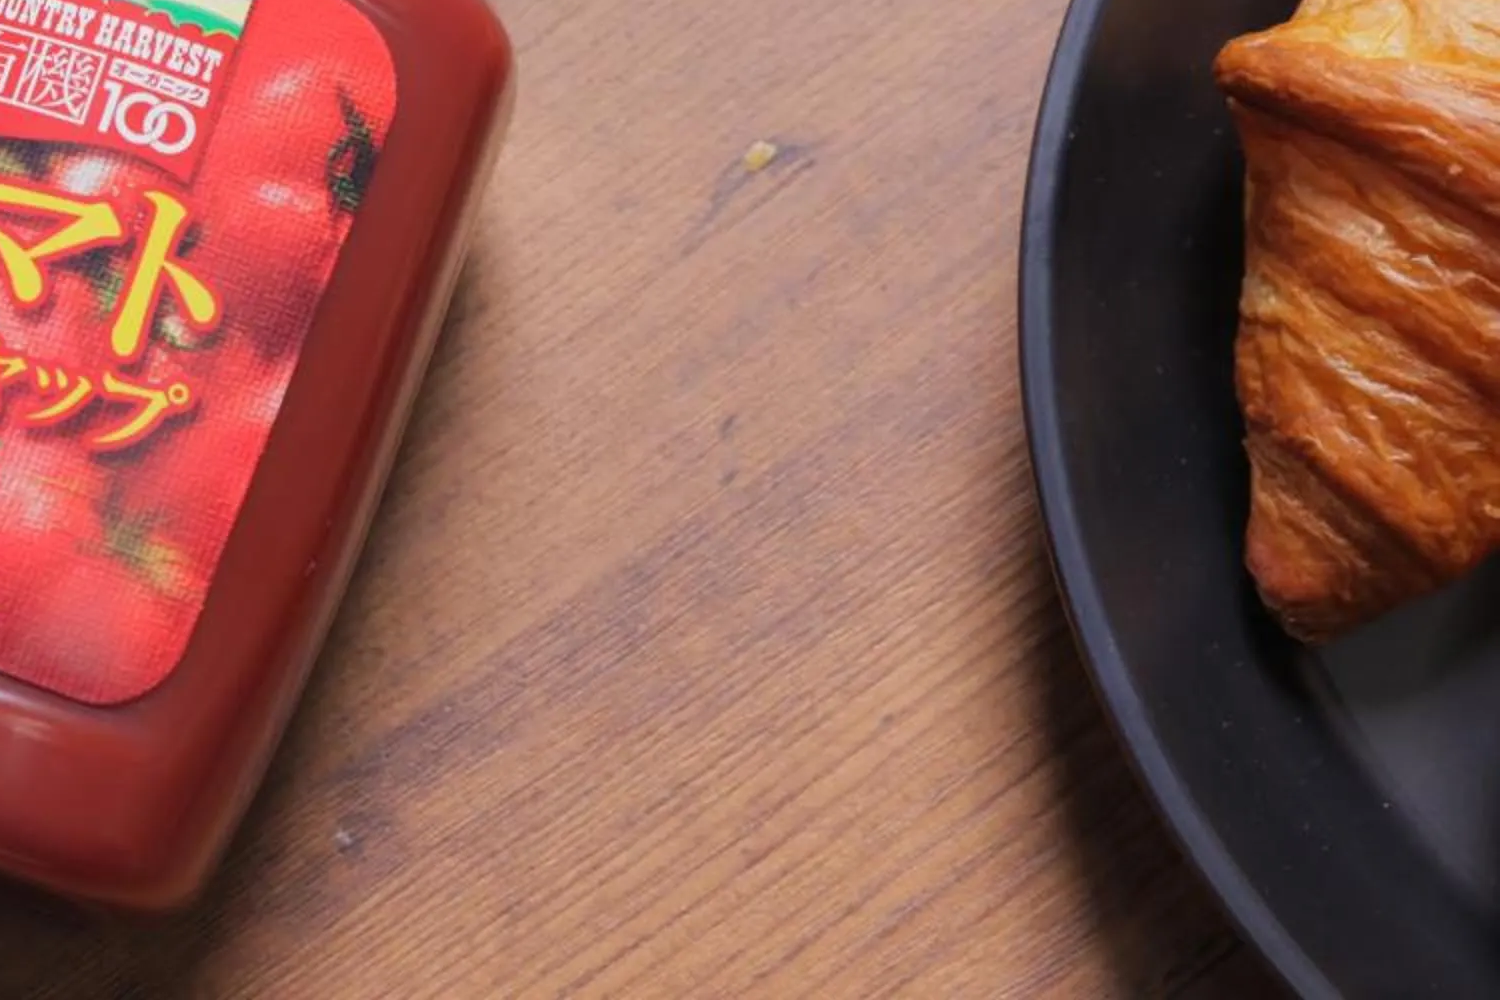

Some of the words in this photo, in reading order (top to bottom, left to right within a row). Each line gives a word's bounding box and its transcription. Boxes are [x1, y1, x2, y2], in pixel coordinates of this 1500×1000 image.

[93, 10, 223, 83] HARVEST
[112, 60, 206, 103] オーガニック
[97, 80, 198, 154] 100
